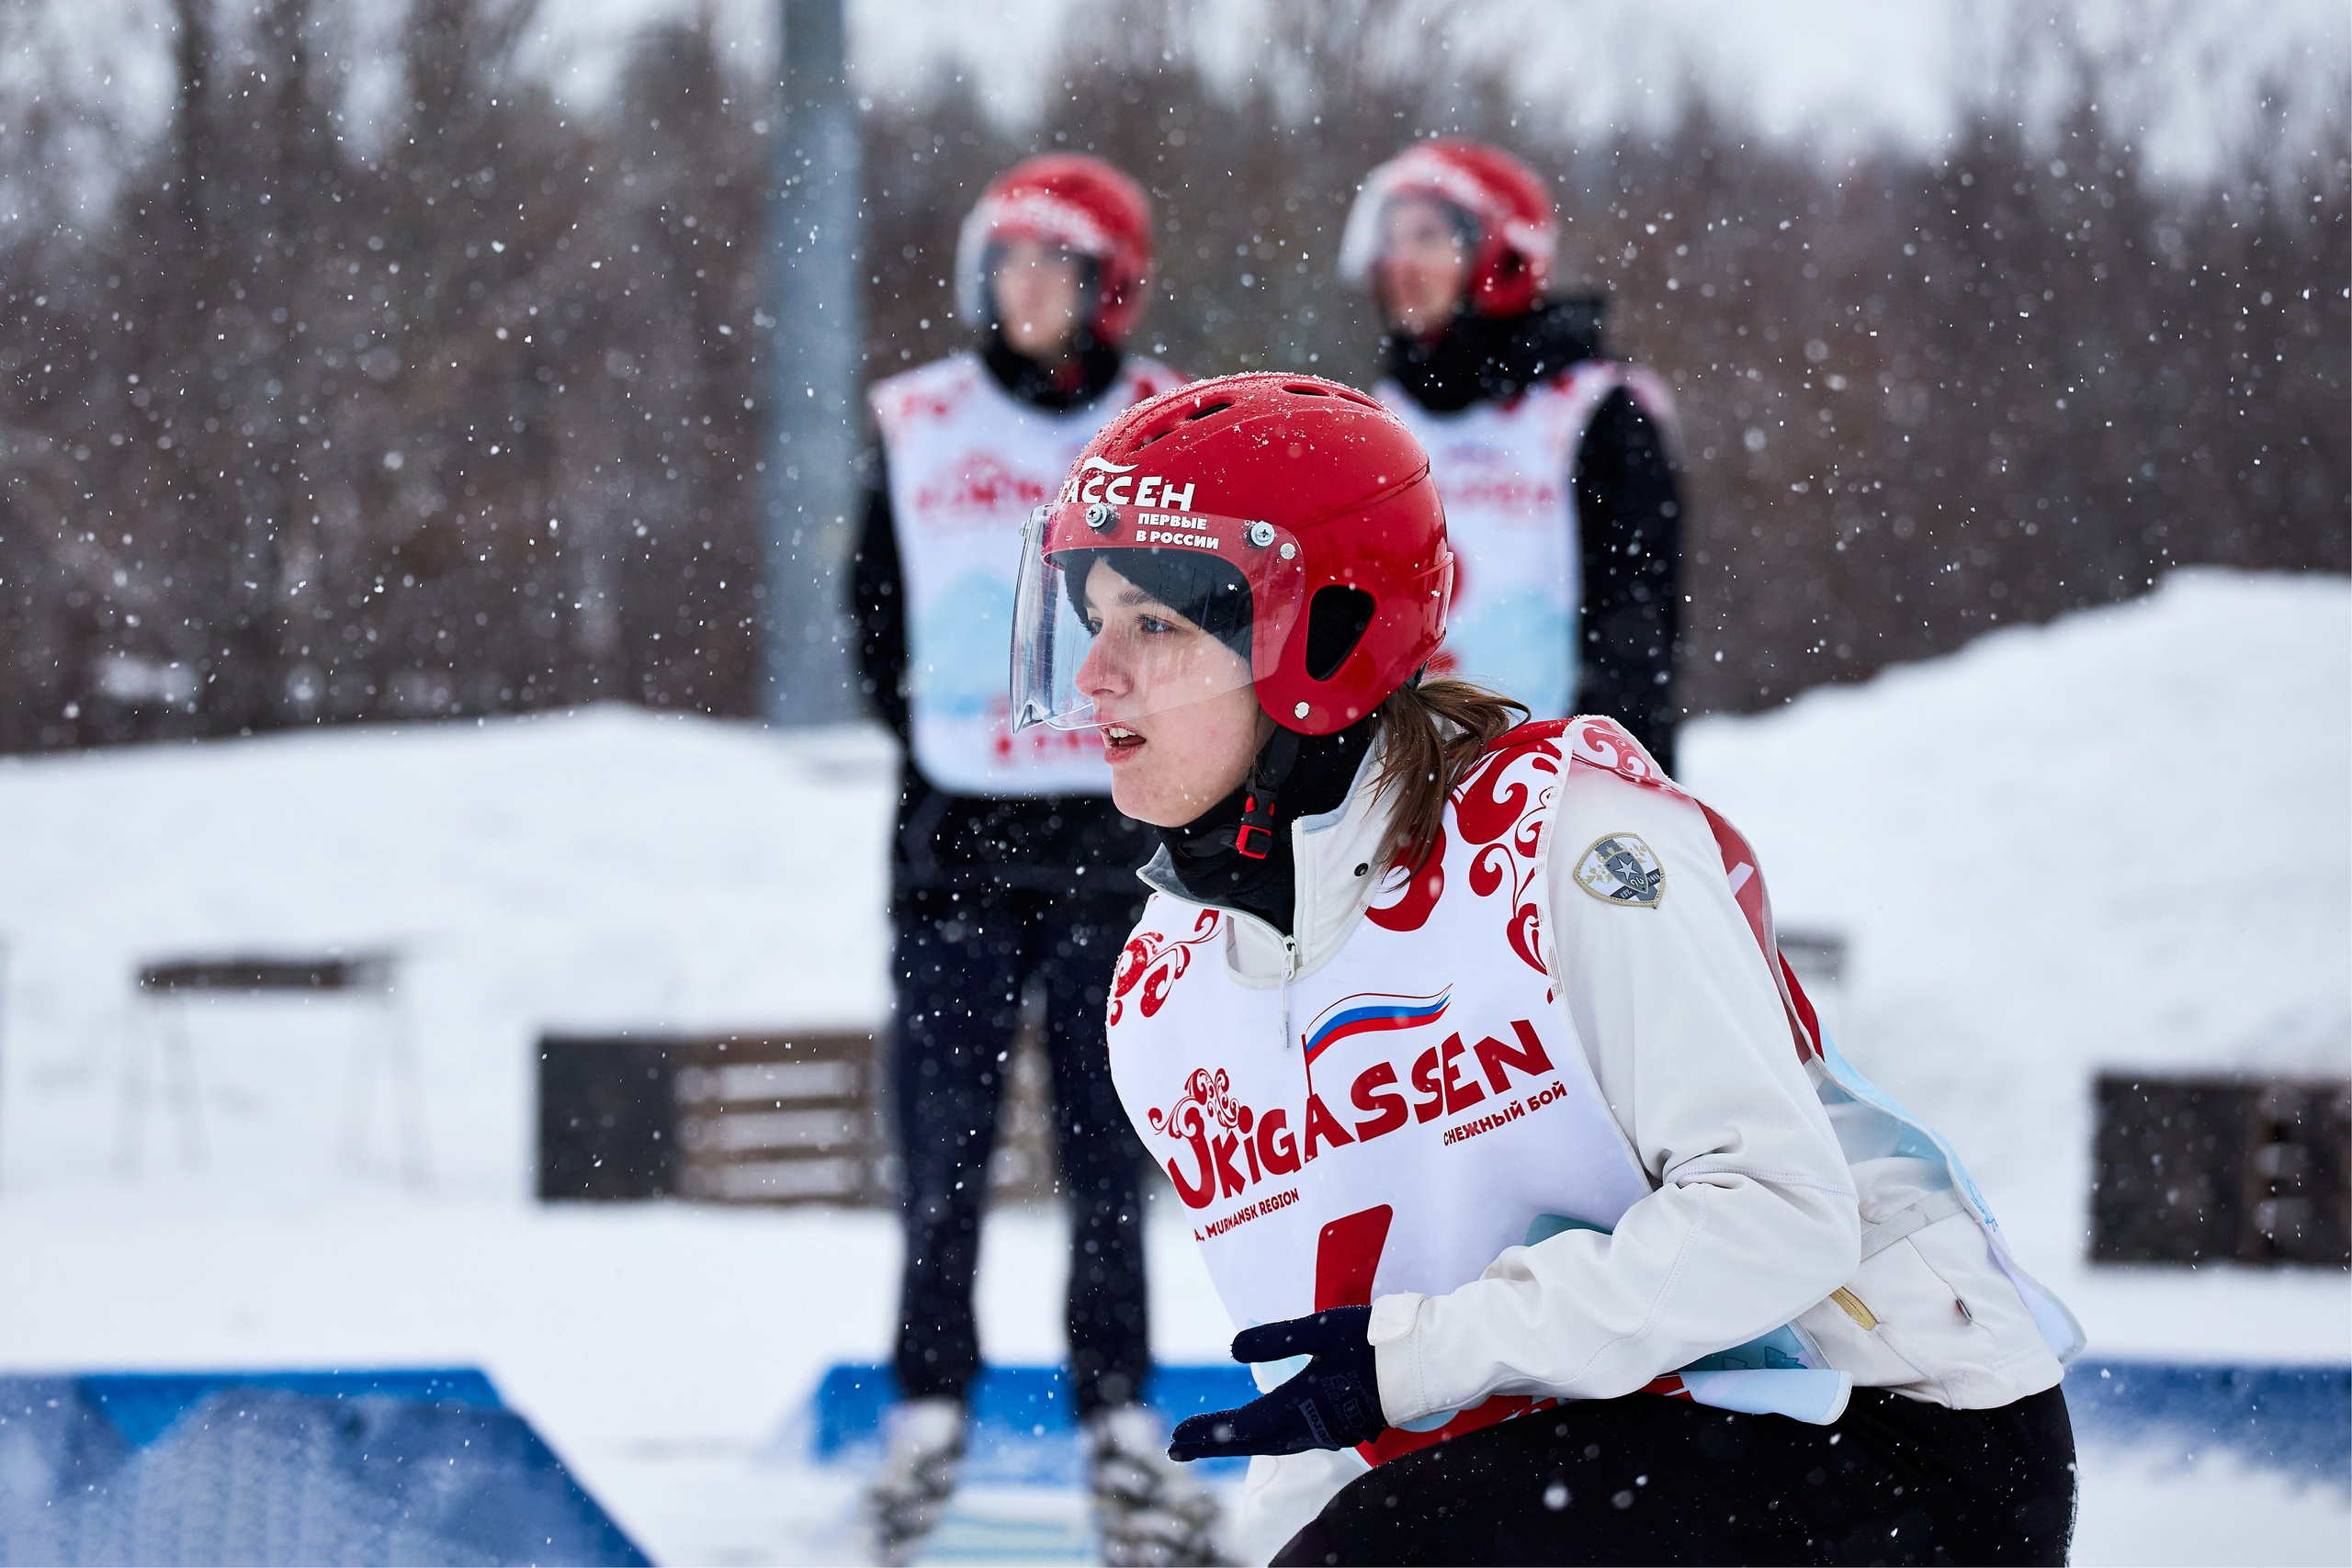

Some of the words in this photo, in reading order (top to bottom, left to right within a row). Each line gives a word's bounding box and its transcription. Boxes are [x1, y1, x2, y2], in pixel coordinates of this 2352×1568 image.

[1137, 513, 1207, 531] ПЕРВЫЕ
[1136, 530, 1148, 542] В
[1149, 531, 1219, 549] РОССИИ
[1443, 1100, 1525, 1146] СНЕЖНЫЙ
[1527, 1080, 1567, 1111] БОЙ
[1204, 1204, 1259, 1238] MURMANSK
[1259, 1188, 1300, 1215] REGION
